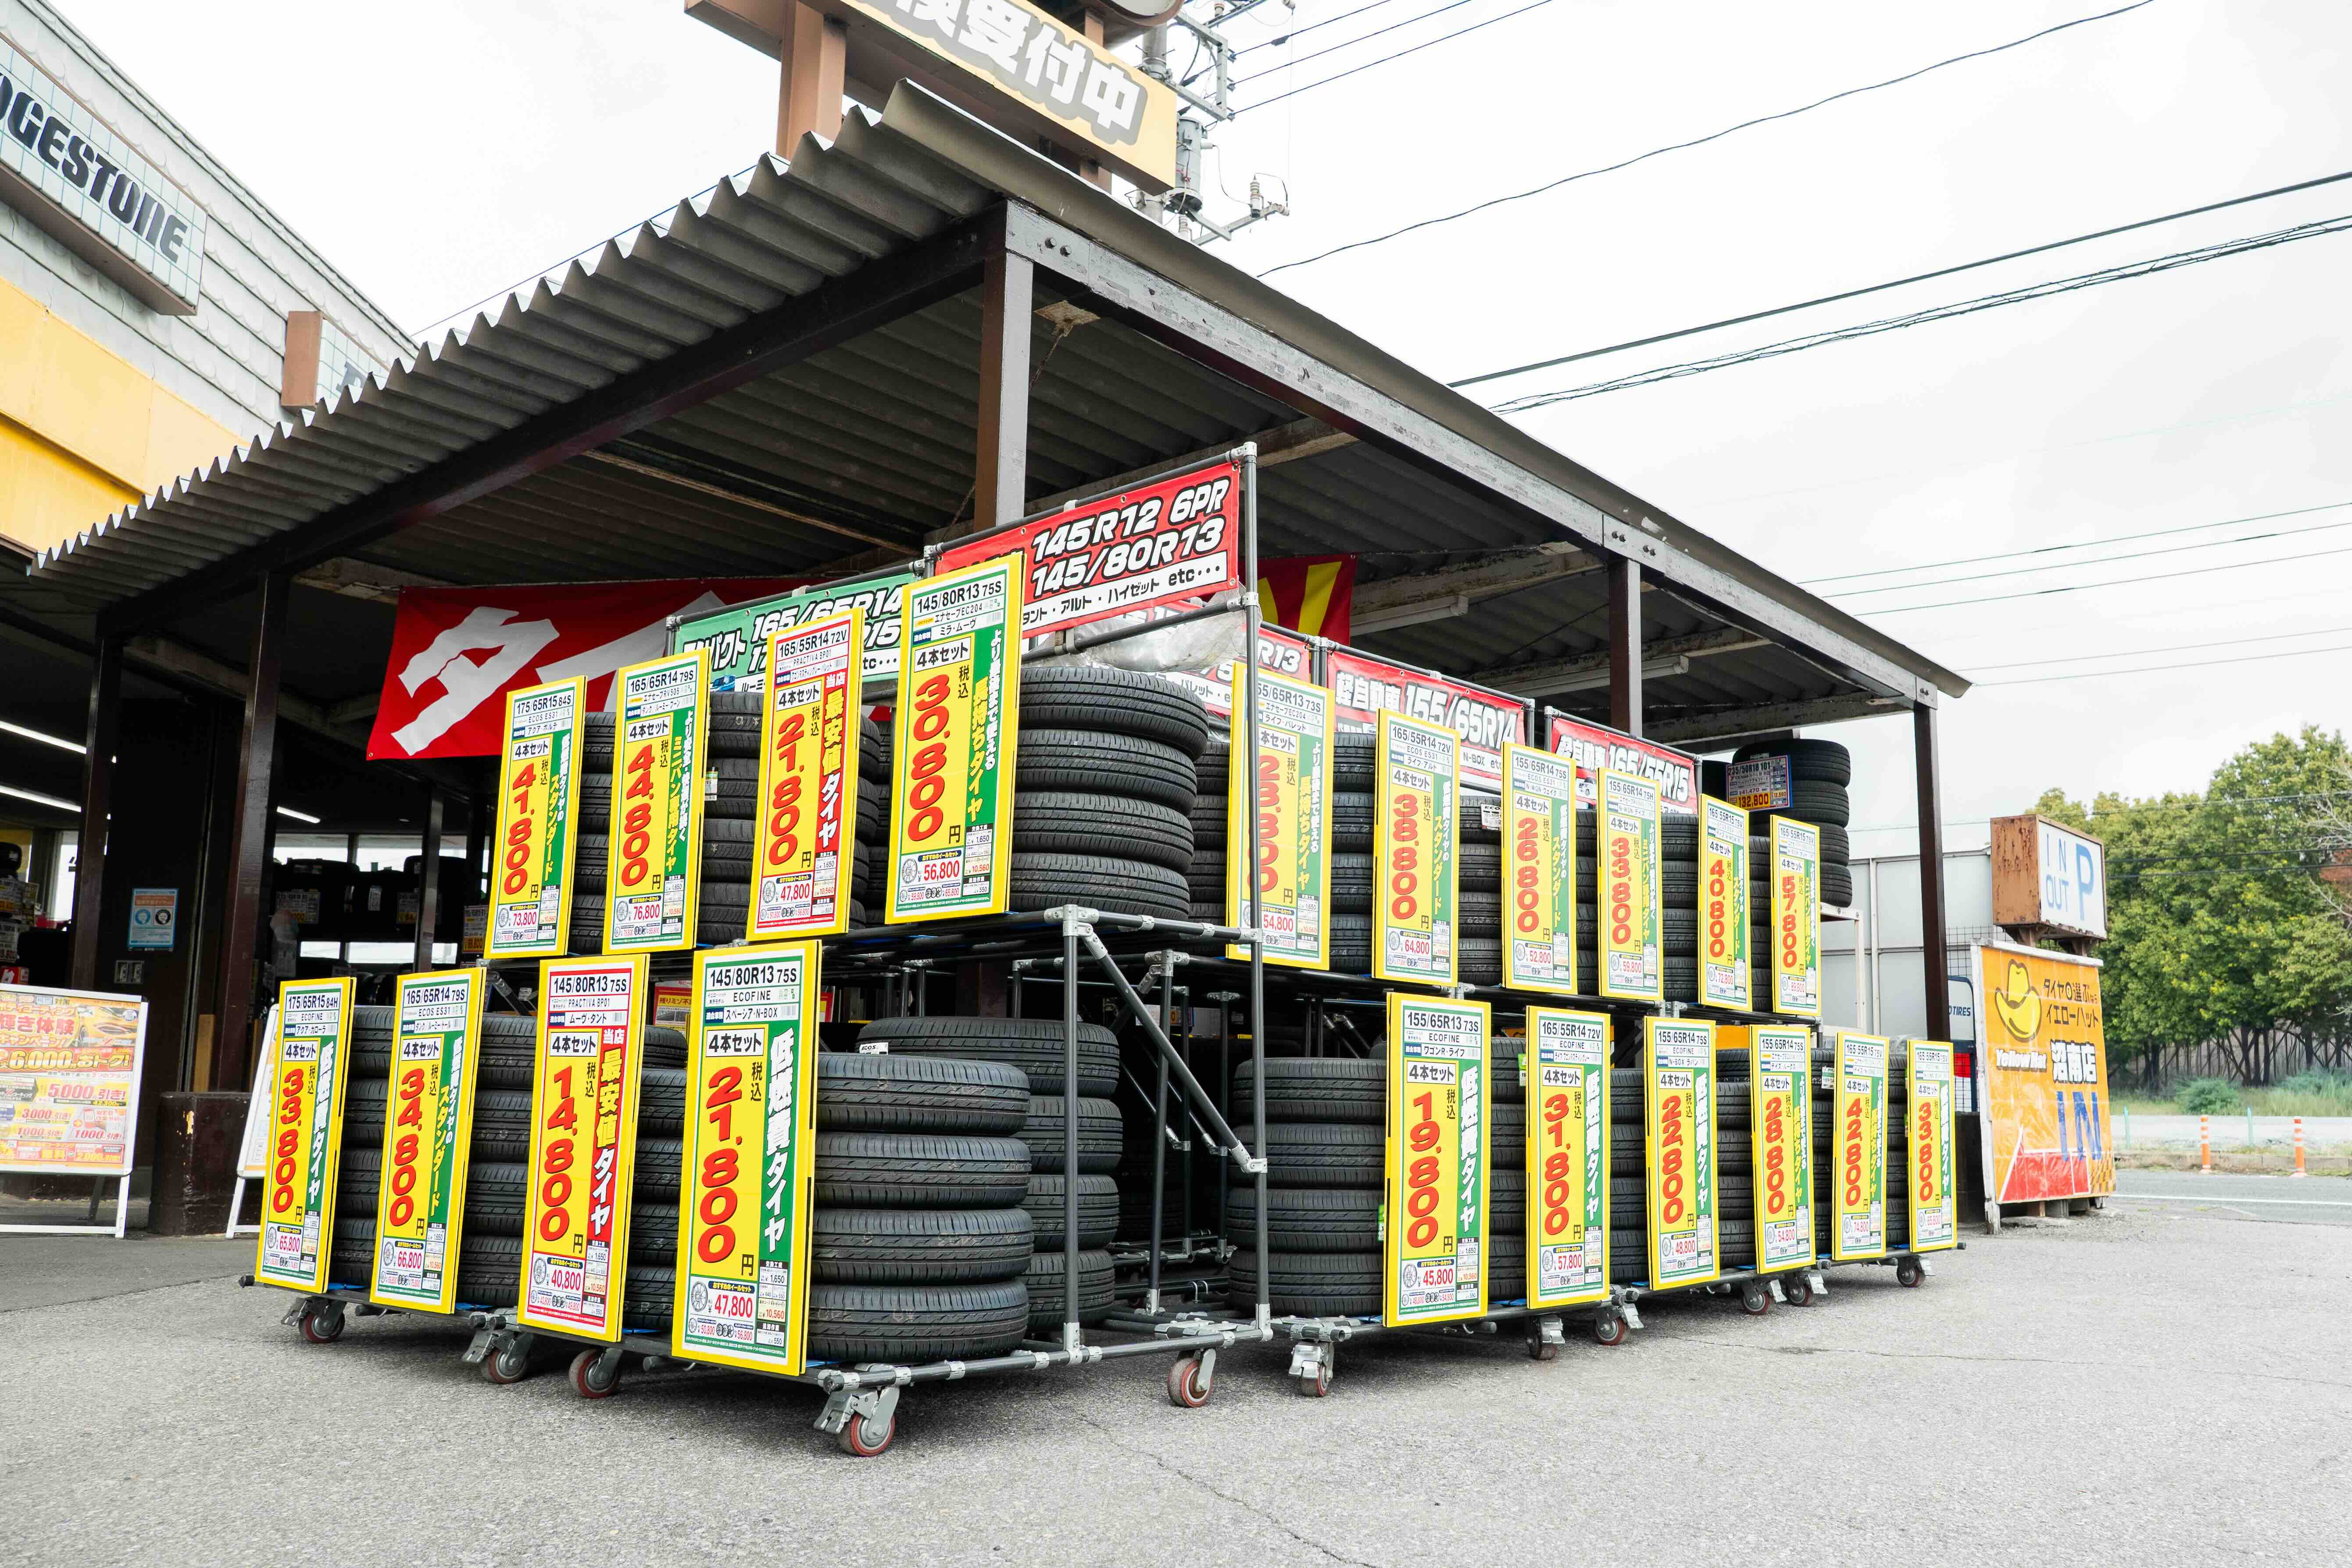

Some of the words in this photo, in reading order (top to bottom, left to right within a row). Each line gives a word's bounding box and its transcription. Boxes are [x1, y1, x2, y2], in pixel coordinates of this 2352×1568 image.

[1032, 498, 1163, 563] 145R12
[1168, 476, 1230, 525] 6PR
[1031, 515, 1226, 598] 145/80R13
[918, 583, 979, 613] 145/80R13
[982, 581, 1001, 596] 75S
[779, 631, 829, 657] 165/55R14
[831, 629, 847, 644] 72V
[917, 642, 969, 667] 4本セット
[631, 671, 678, 693] 165/65R14
[679, 670, 693, 682] 79S
[958, 664, 969, 699] 税込
[517, 695, 558, 714] 175/65R15
[558, 695, 571, 707] 84S
[779, 685, 819, 707] 4本セット
[1257, 681, 1305, 711] 55/65R13
[1305, 699, 1321, 713] 73S
[629, 720, 668, 739] 4本セット
[515, 740, 548, 757] 4本セット
[1260, 730, 1295, 751] 本セット
[1393, 726, 1436, 749] 165/55R14
[1437, 742, 1451, 754] 72V
[1394, 770, 1430, 789] 4本セット
[1738, 793, 1769, 807] 132,800
[948, 825, 961, 844] 円
[2046, 833, 2066, 873] IN
[924, 860, 960, 881] 56,800
[2076, 842, 2094, 921] P
[780, 883, 810, 902] 47,800
[2046, 875, 2069, 913] OUT
[513, 911, 537, 927] 73,800
[633, 904, 660, 920] 76,800
[1263, 914, 1294, 932] 54,800
[1405, 939, 1430, 955] 64,800
[554, 976, 608, 993] 145/80R13
[610, 979, 626, 993] 75S
[711, 965, 774, 987] 145/80R13
[777, 968, 797, 983] 75S
[289, 995, 325, 1009] 175/65R15
[326, 997, 338, 1008] 84H
[407, 986, 450, 1004] 165/65R14
[452, 989, 465, 1001] 79S
[733, 990, 771, 1002] ECOFINE
[301, 1013, 323, 1021] ECOFINE
[1408, 1012, 1462, 1030] 155/65R13
[1464, 1021, 1479, 1032] 73S
[603, 1029, 625, 1044] 当店
[1429, 1033, 1460, 1043] ECOFINE
[1542, 1022, 1586, 1037] 165/55R14
[1587, 1029, 1601, 1039] 72V
[286, 1043, 316, 1058] 4本セット
[403, 1041, 439, 1057] 4本セット
[552, 1036, 596, 1053] 4本セット
[708, 1033, 761, 1053] 4本セット
[1560, 1040, 1585, 1049] ECOFINE
[585, 1062, 596, 1098] 税込
[751, 1061, 762, 1101] 税込
[1409, 1064, 1454, 1081] 4本セット
[1544, 1069, 1580, 1085] 4本セット
[1447, 1089, 1456, 1119] 税込
[2056, 1091, 2102, 1161] IN
[279, 1235, 300, 1253] 65,800
[573, 1233, 583, 1254] 円
[1443, 1236, 1453, 1253] 円
[397, 1251, 422, 1269] 66,800
[741, 1254, 754, 1276] 円
[1558, 1254, 1582, 1270] 57,800
[551, 1269, 581, 1291] 40,800
[1423, 1268, 1453, 1286] 45,800
[715, 1294, 753, 1318] 47,800
